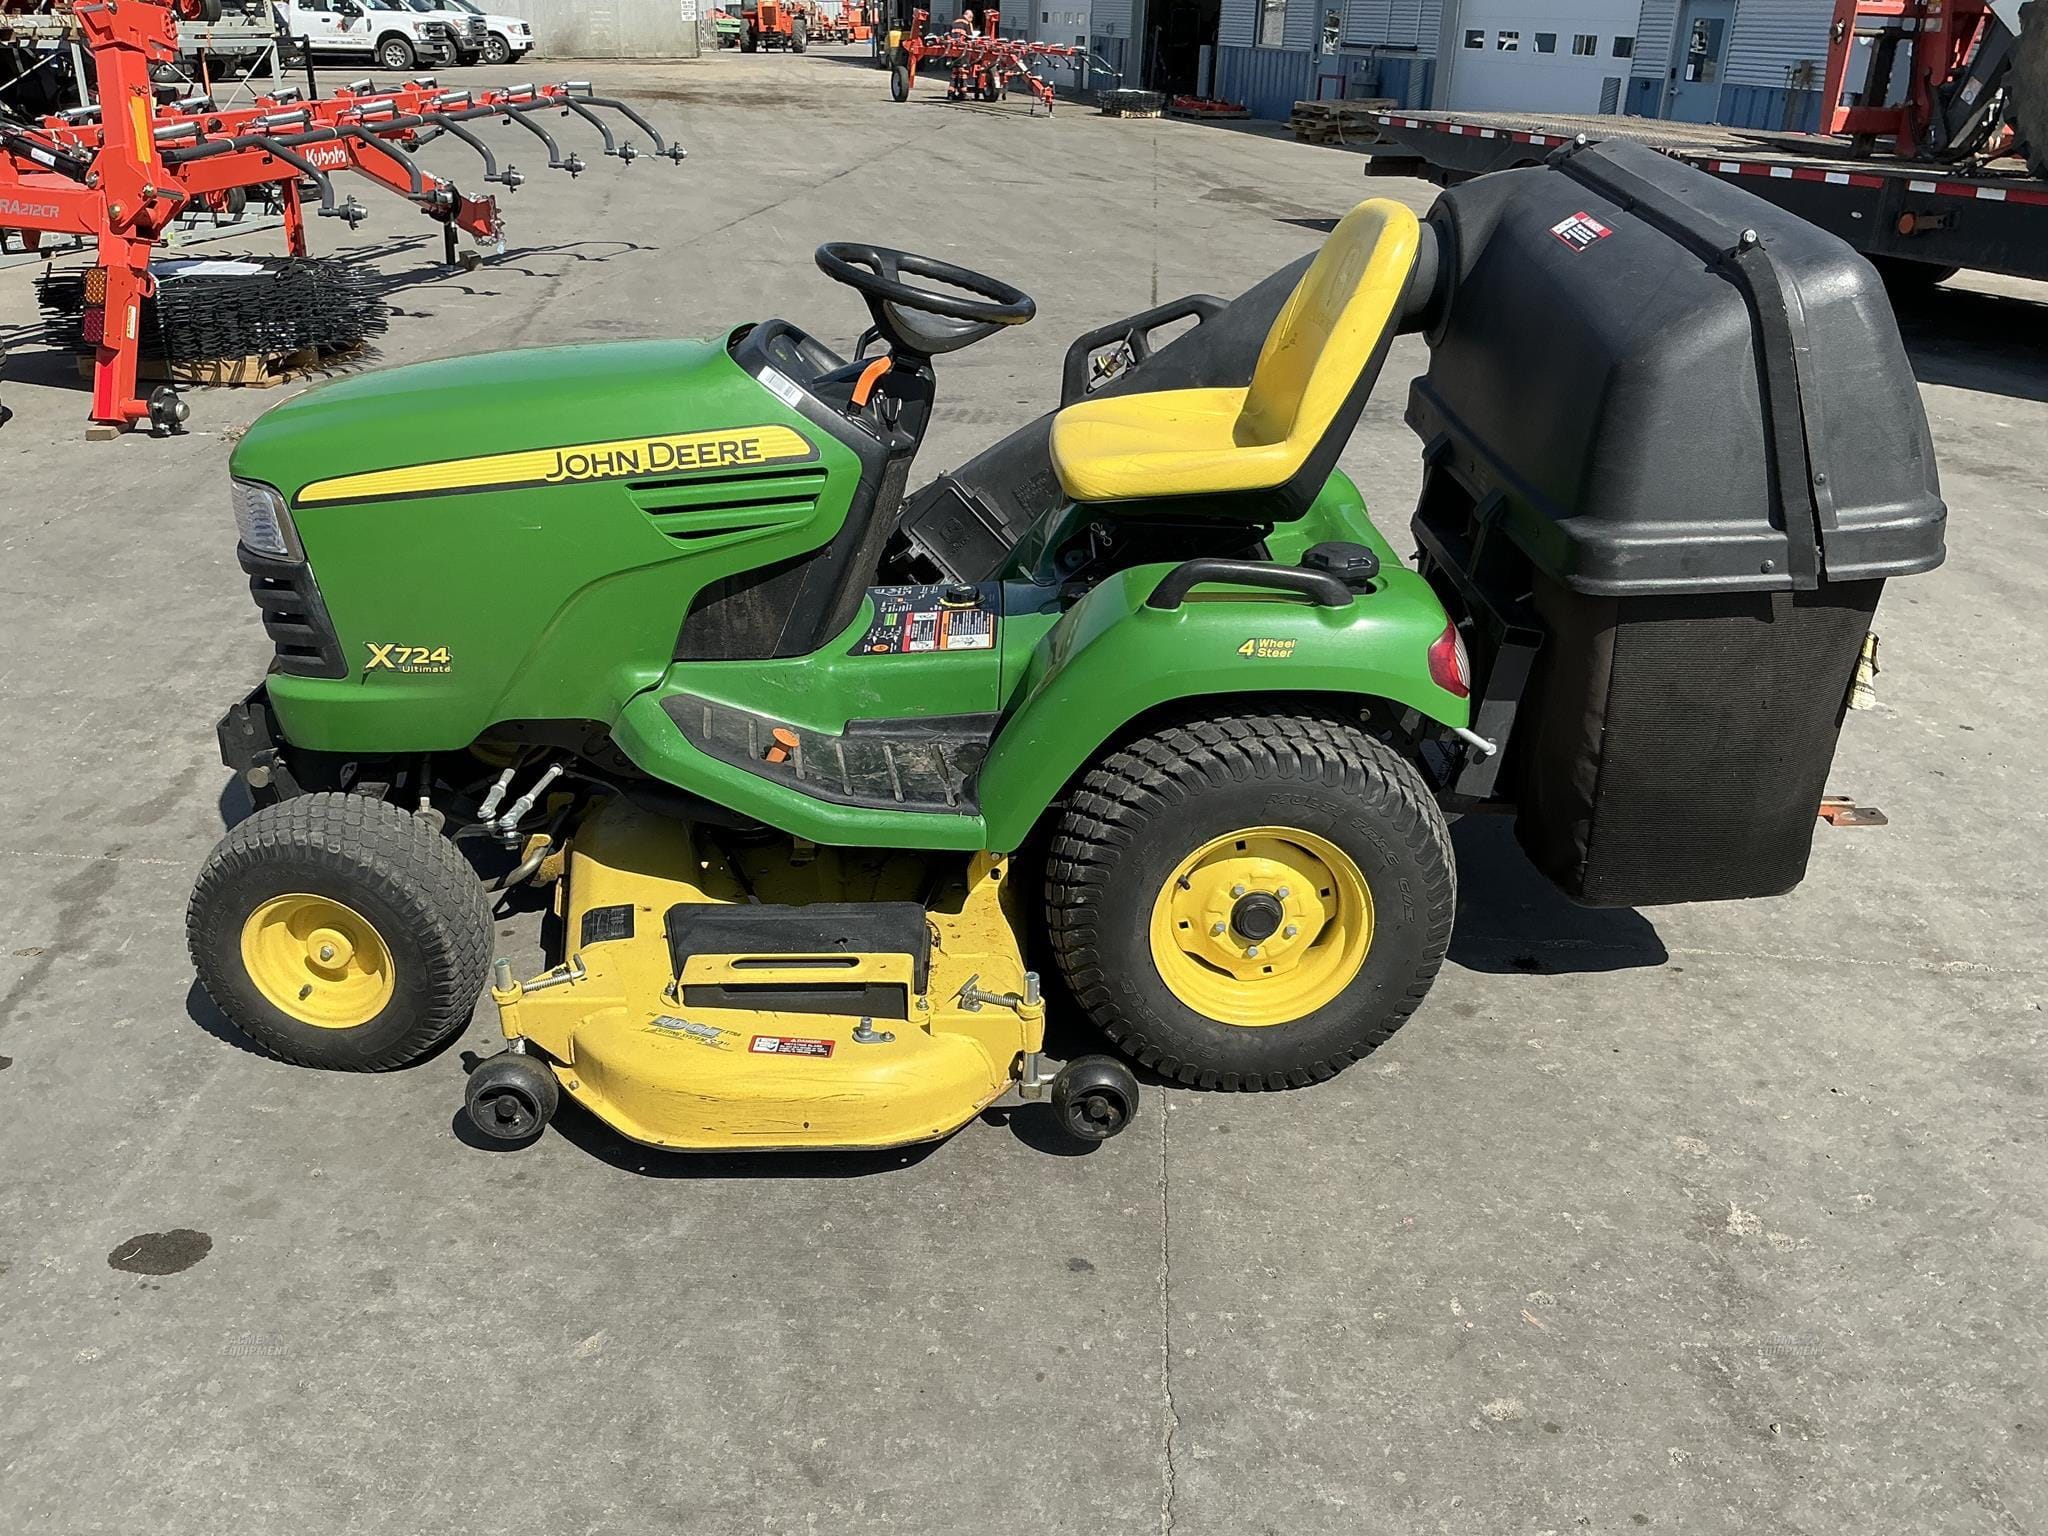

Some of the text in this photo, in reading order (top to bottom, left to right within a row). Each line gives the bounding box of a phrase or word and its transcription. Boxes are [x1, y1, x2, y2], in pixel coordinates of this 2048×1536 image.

[305, 146, 346, 167] Kubota
[546, 438, 762, 478] JOHN DEERE
[365, 643, 450, 669] X724
[1238, 639, 1296, 656] 4 Wheel
[1257, 648, 1293, 658] Steer
[402, 665, 452, 673] Ultimate
